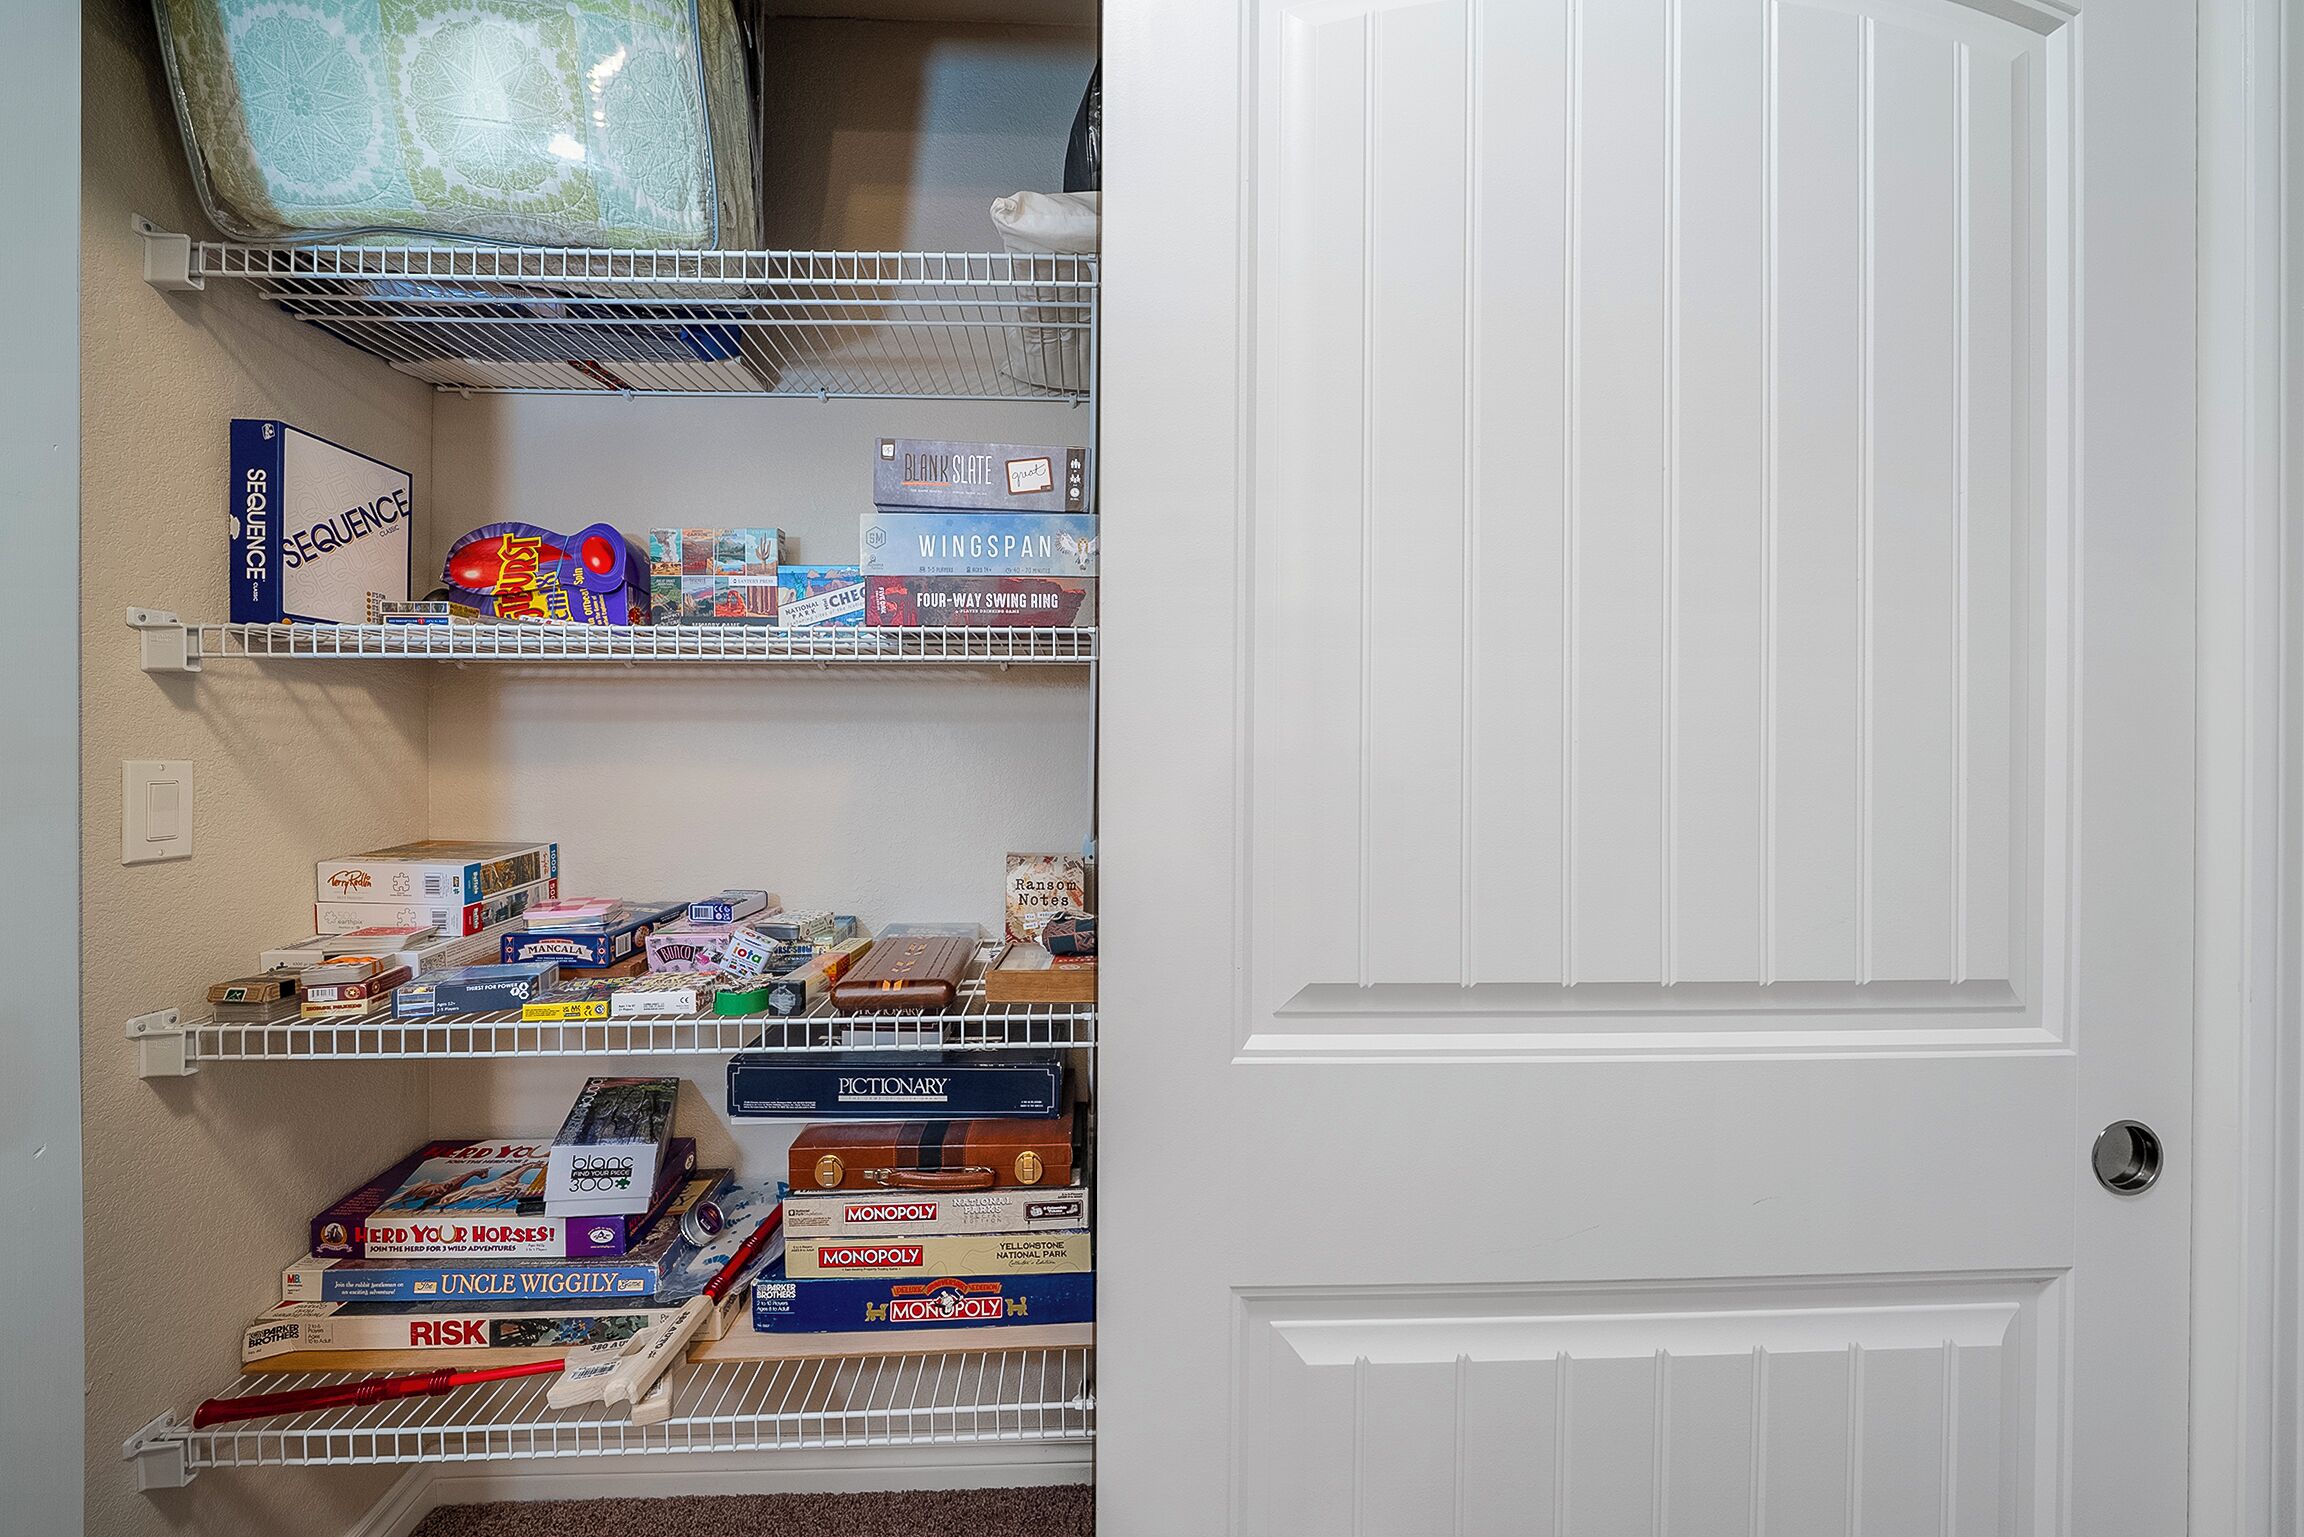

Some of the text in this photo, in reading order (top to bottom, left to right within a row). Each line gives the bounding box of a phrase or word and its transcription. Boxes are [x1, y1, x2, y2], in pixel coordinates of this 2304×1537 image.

[904, 453, 993, 485] BLANK SLATE
[1012, 463, 1046, 487] great
[246, 468, 267, 579] SEQUENCE
[283, 489, 410, 568] SEQUENCE
[379, 525, 400, 537] CLASSIC
[919, 535, 1051, 558] WINGSPAN
[573, 567, 585, 585] Spin
[785, 601, 819, 615] NATIONAL
[917, 593, 1059, 608] FOUR-WAY SWING RING
[792, 609, 817, 619] PARK
[327, 870, 348, 895] Terry
[1015, 879, 1077, 890] Ransom
[1018, 893, 1069, 906] Notes
[528, 944, 583, 955] MANCALA
[660, 945, 692, 961] BUNCO
[732, 942, 763, 964] iota
[838, 1077, 948, 1095] PICTIONARY
[572, 1154, 634, 1169] blanc
[569, 1177, 613, 1192] 300
[953, 1197, 1013, 1208] NATIONAL
[847, 1205, 935, 1221] MONOPOLY
[964, 1206, 1002, 1215] PARKS
[355, 1224, 555, 1244] HERD YOUR HORSES!
[1000, 1242, 1064, 1250] YELLOWSTONE
[823, 1249, 919, 1264] MONOPOLY
[997, 1250, 1067, 1259] NATIONAL PARK
[417, 1280, 433, 1290] The
[441, 1274, 517, 1294] UNCLE
[520, 1272, 619, 1293] WIGGILY
[767, 1284, 796, 1292] PARKER
[370, 1288, 396, 1296] adventure!
[757, 1291, 797, 1299] BROTHERS
[264, 1324, 299, 1336] PARKER
[410, 1319, 488, 1346] RISK
[248, 1331, 299, 1348] BROTHERS
